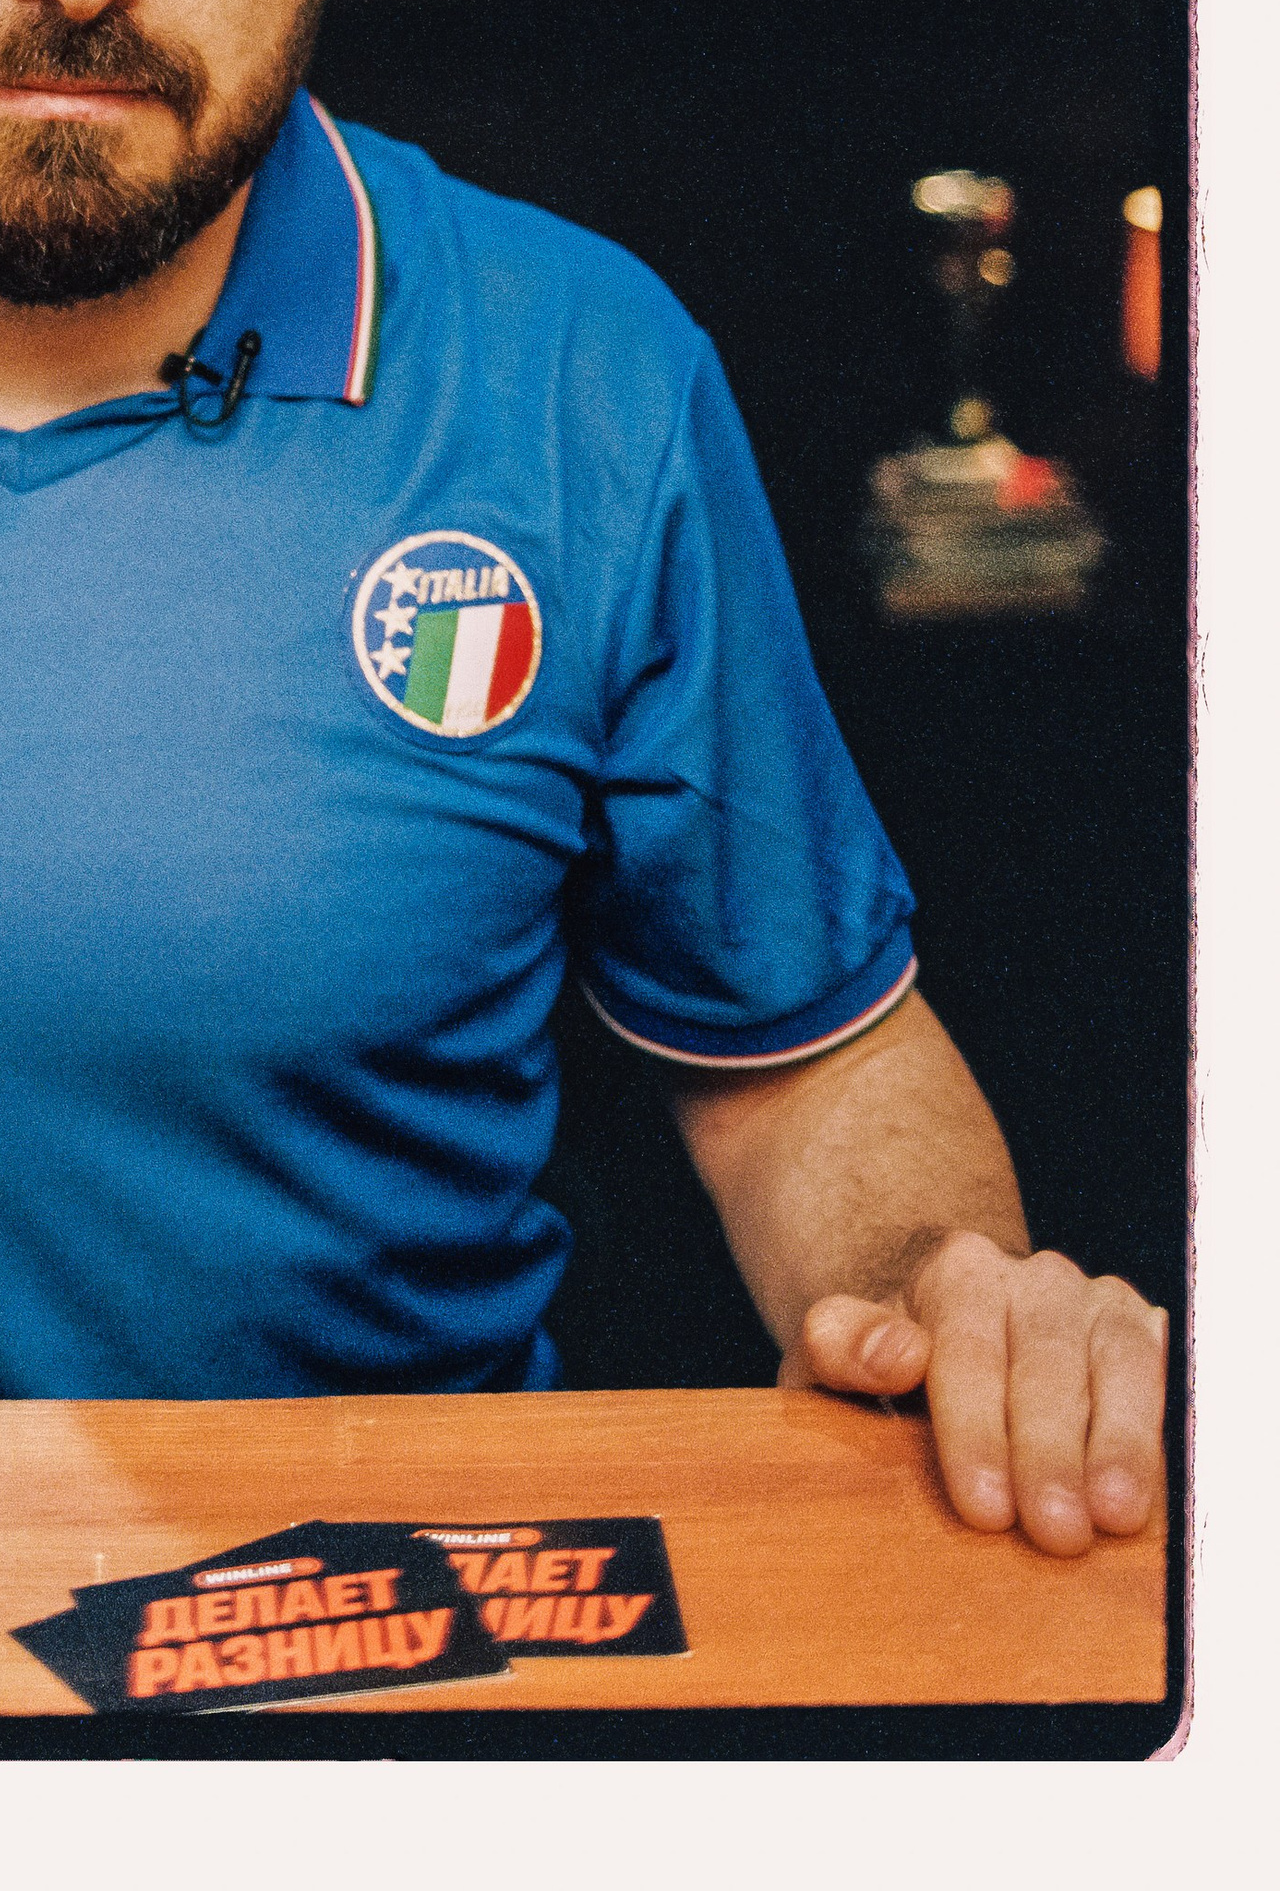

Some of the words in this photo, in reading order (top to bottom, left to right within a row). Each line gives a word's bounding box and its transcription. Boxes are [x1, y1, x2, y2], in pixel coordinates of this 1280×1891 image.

[416, 565, 509, 605] ITALIA
[204, 1561, 293, 1586] WINLINE
[136, 1567, 401, 1648] ДЕЛАЕТ
[126, 1607, 453, 1699] РАЗНИЦУ
